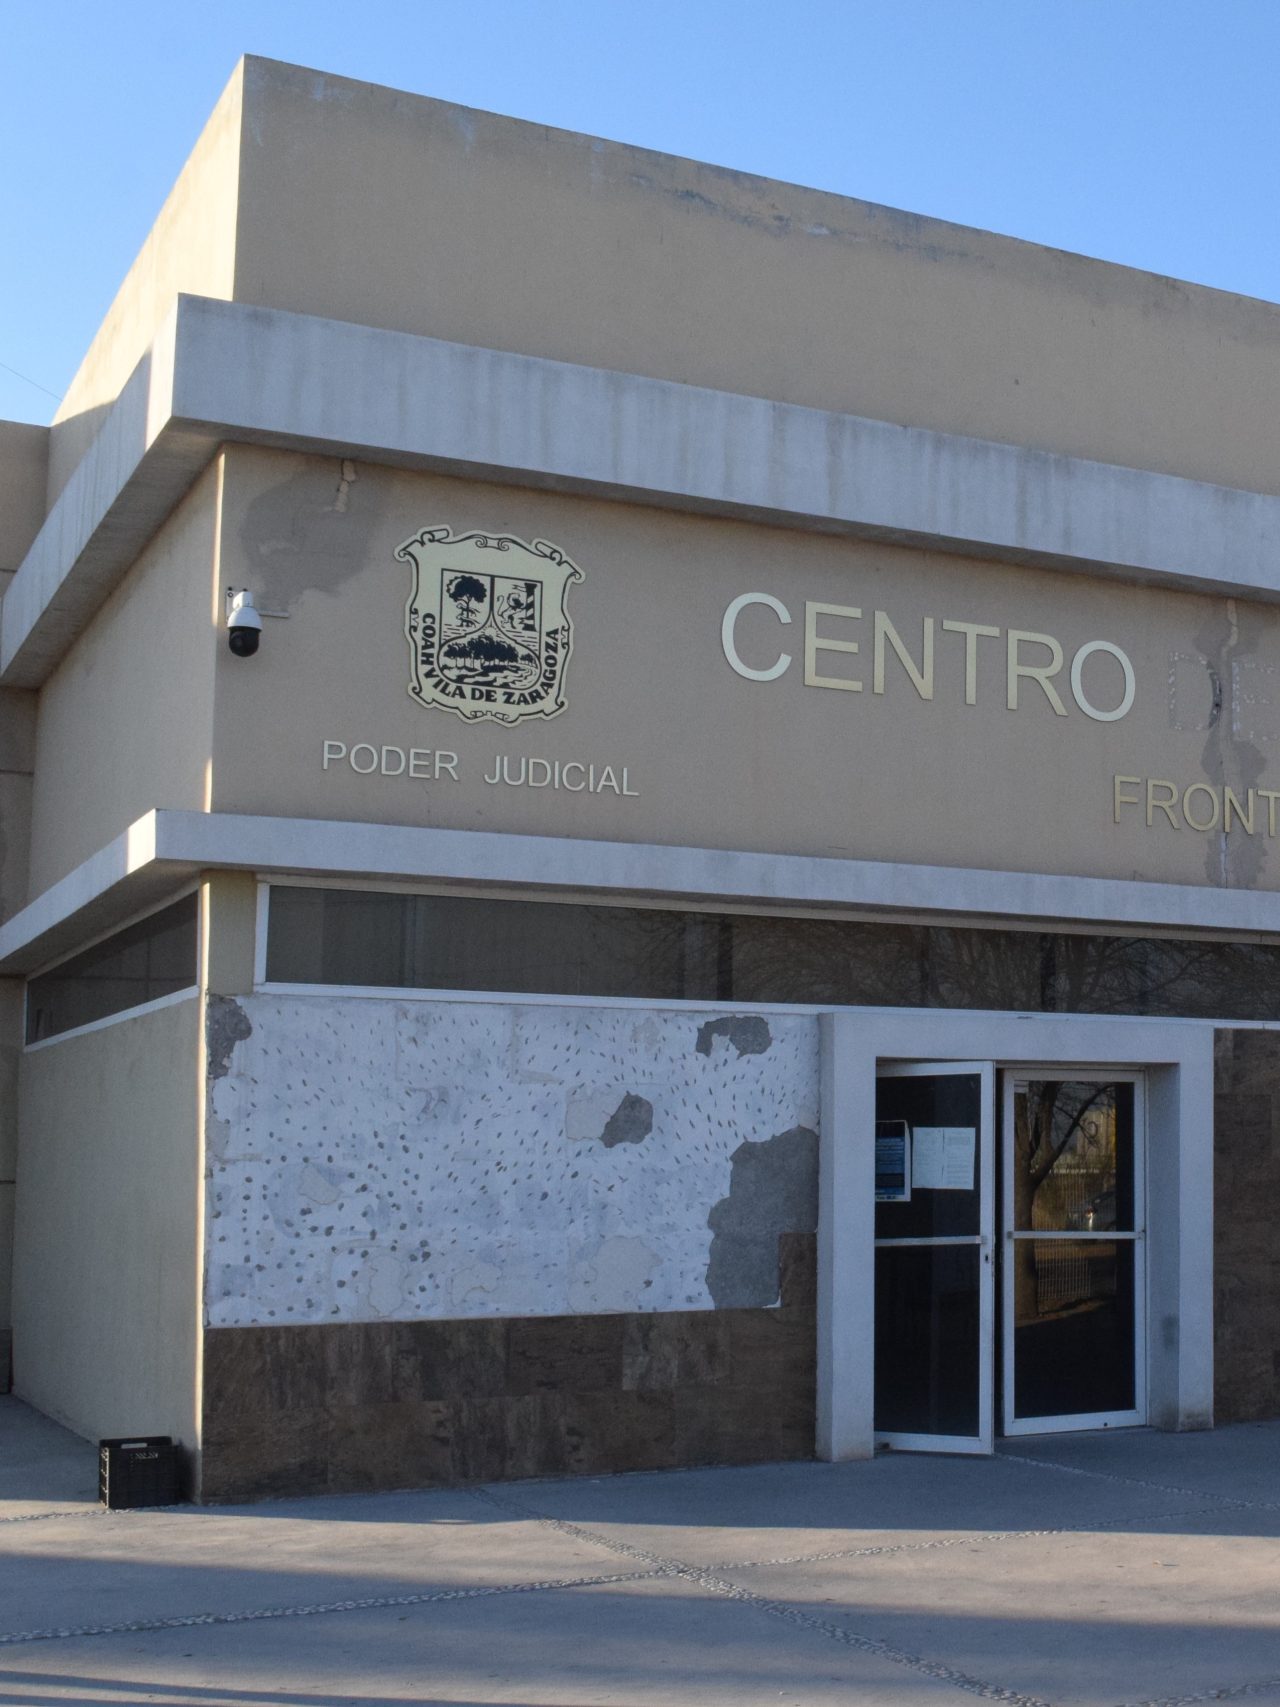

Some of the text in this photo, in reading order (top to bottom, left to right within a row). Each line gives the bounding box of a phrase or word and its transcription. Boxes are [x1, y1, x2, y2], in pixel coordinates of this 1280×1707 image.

[470, 687, 498, 703] DE
[502, 627, 560, 706] ZARAGOZA
[721, 591, 1137, 723] CENTRO
[321, 740, 640, 796] PODER JUDICIAL
